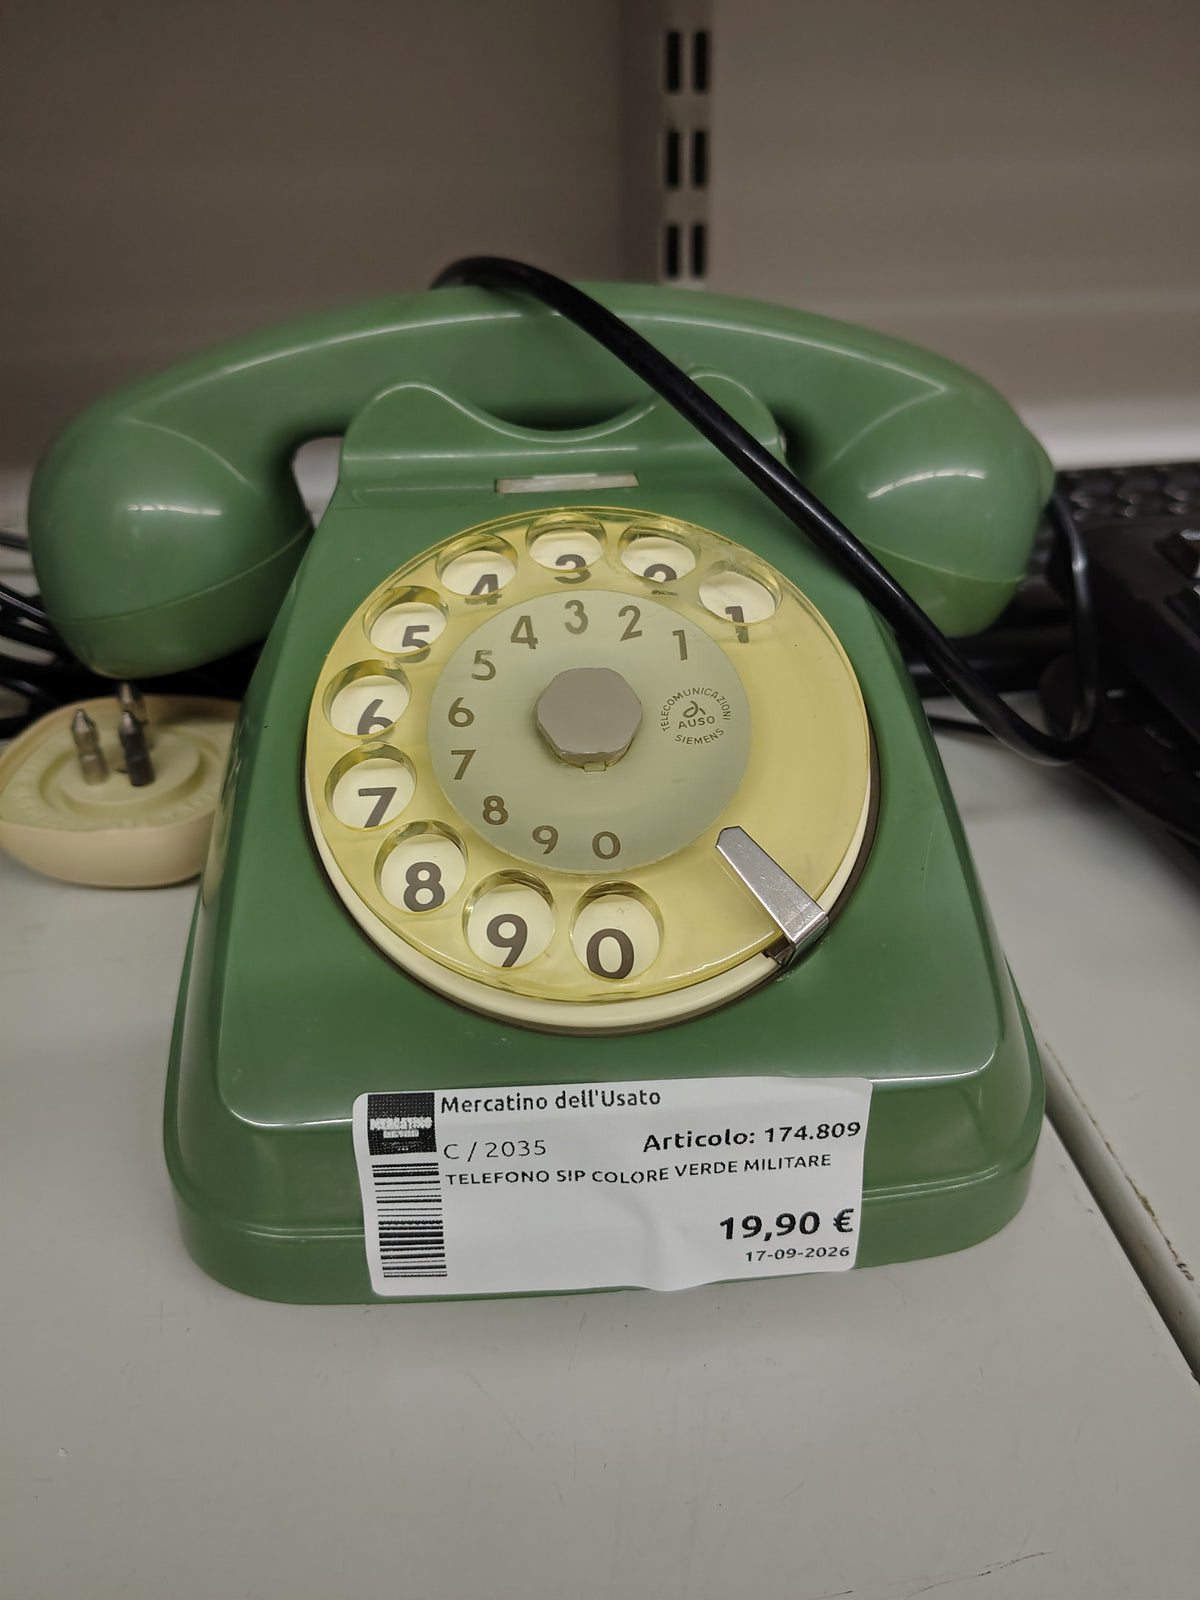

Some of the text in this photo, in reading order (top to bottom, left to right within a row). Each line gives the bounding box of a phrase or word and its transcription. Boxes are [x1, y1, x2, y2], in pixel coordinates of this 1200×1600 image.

[554, 554, 592, 584] 3
[464, 573, 502, 606] 4
[510, 615, 539, 650] 4
[564, 600, 588, 635] 3
[618, 605, 642, 641] 2
[725, 605, 749, 643] 1
[402, 624, 431, 663] 5
[672, 629, 688, 661] 1
[471, 649, 497, 681] 5
[357, 698, 395, 742] 6
[447, 697, 474, 728] 6
[660, 687, 731, 732] TELECOMUNICAZIONI
[678, 715, 716, 729] AUSO
[675, 728, 724, 745] SIEMENS
[450, 749, 476, 780] 7
[357, 786, 397, 828] 7
[482, 795, 509, 825] 8
[532, 825, 559, 854] 9
[592, 831, 621, 860] 0
[403, 861, 445, 913] 8
[486, 913, 528, 968] 9
[586, 928, 635, 980] 0
[441, 1089, 661, 1114] Mercatino dell'Usato
[443, 1139, 547, 1162] C / 2035
[643, 1121, 861, 1153] Articolo: 174.809
[445, 1170, 550, 1186] TELEFONO
[592, 1167, 669, 1184] COLORE
[674, 1161, 738, 1177] VERDE
[744, 1154, 831, 1172] MILITARE
[719, 1208, 854, 1242] 19,90 €
[746, 1246, 850, 1262] 17-09-2026
